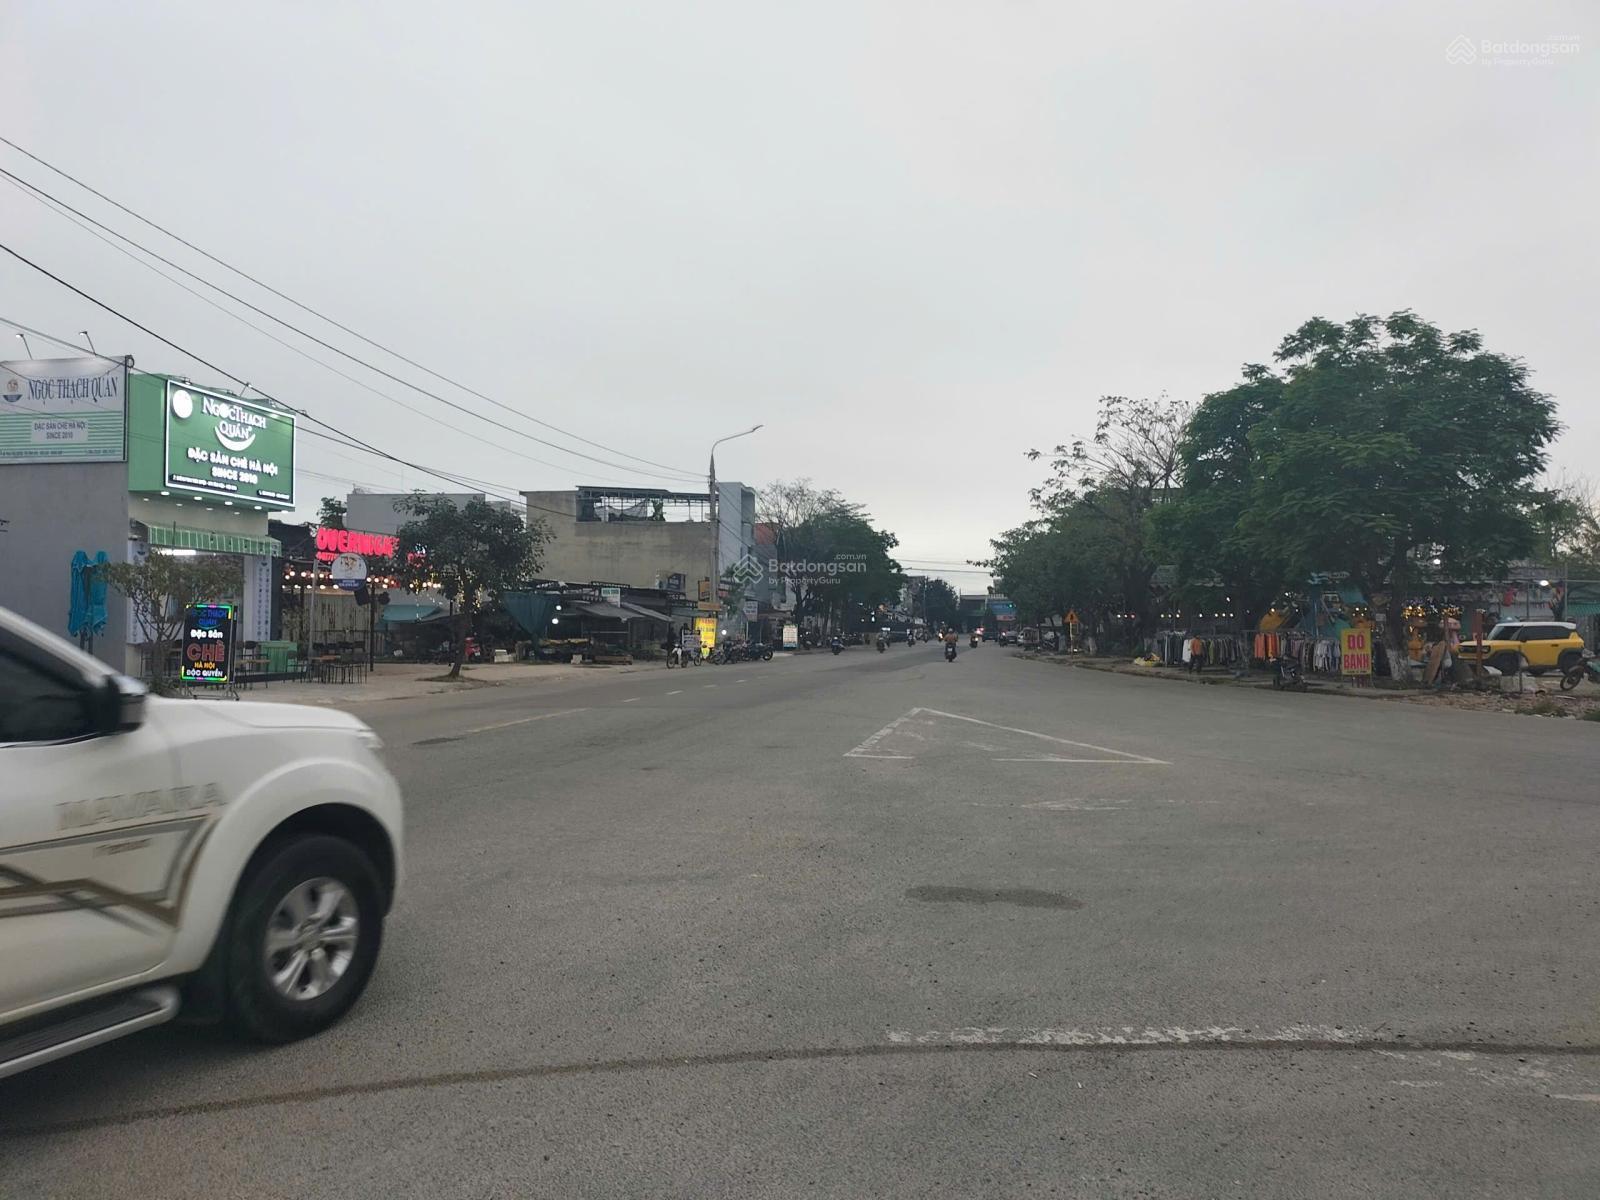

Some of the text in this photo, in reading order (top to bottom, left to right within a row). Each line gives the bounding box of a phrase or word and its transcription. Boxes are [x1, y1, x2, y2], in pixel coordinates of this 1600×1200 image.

[249, 460, 261, 471] HÀ
[212, 467, 238, 480] SINCE
[239, 472, 258, 484] 2010
[186, 639, 225, 662] CHÈ
